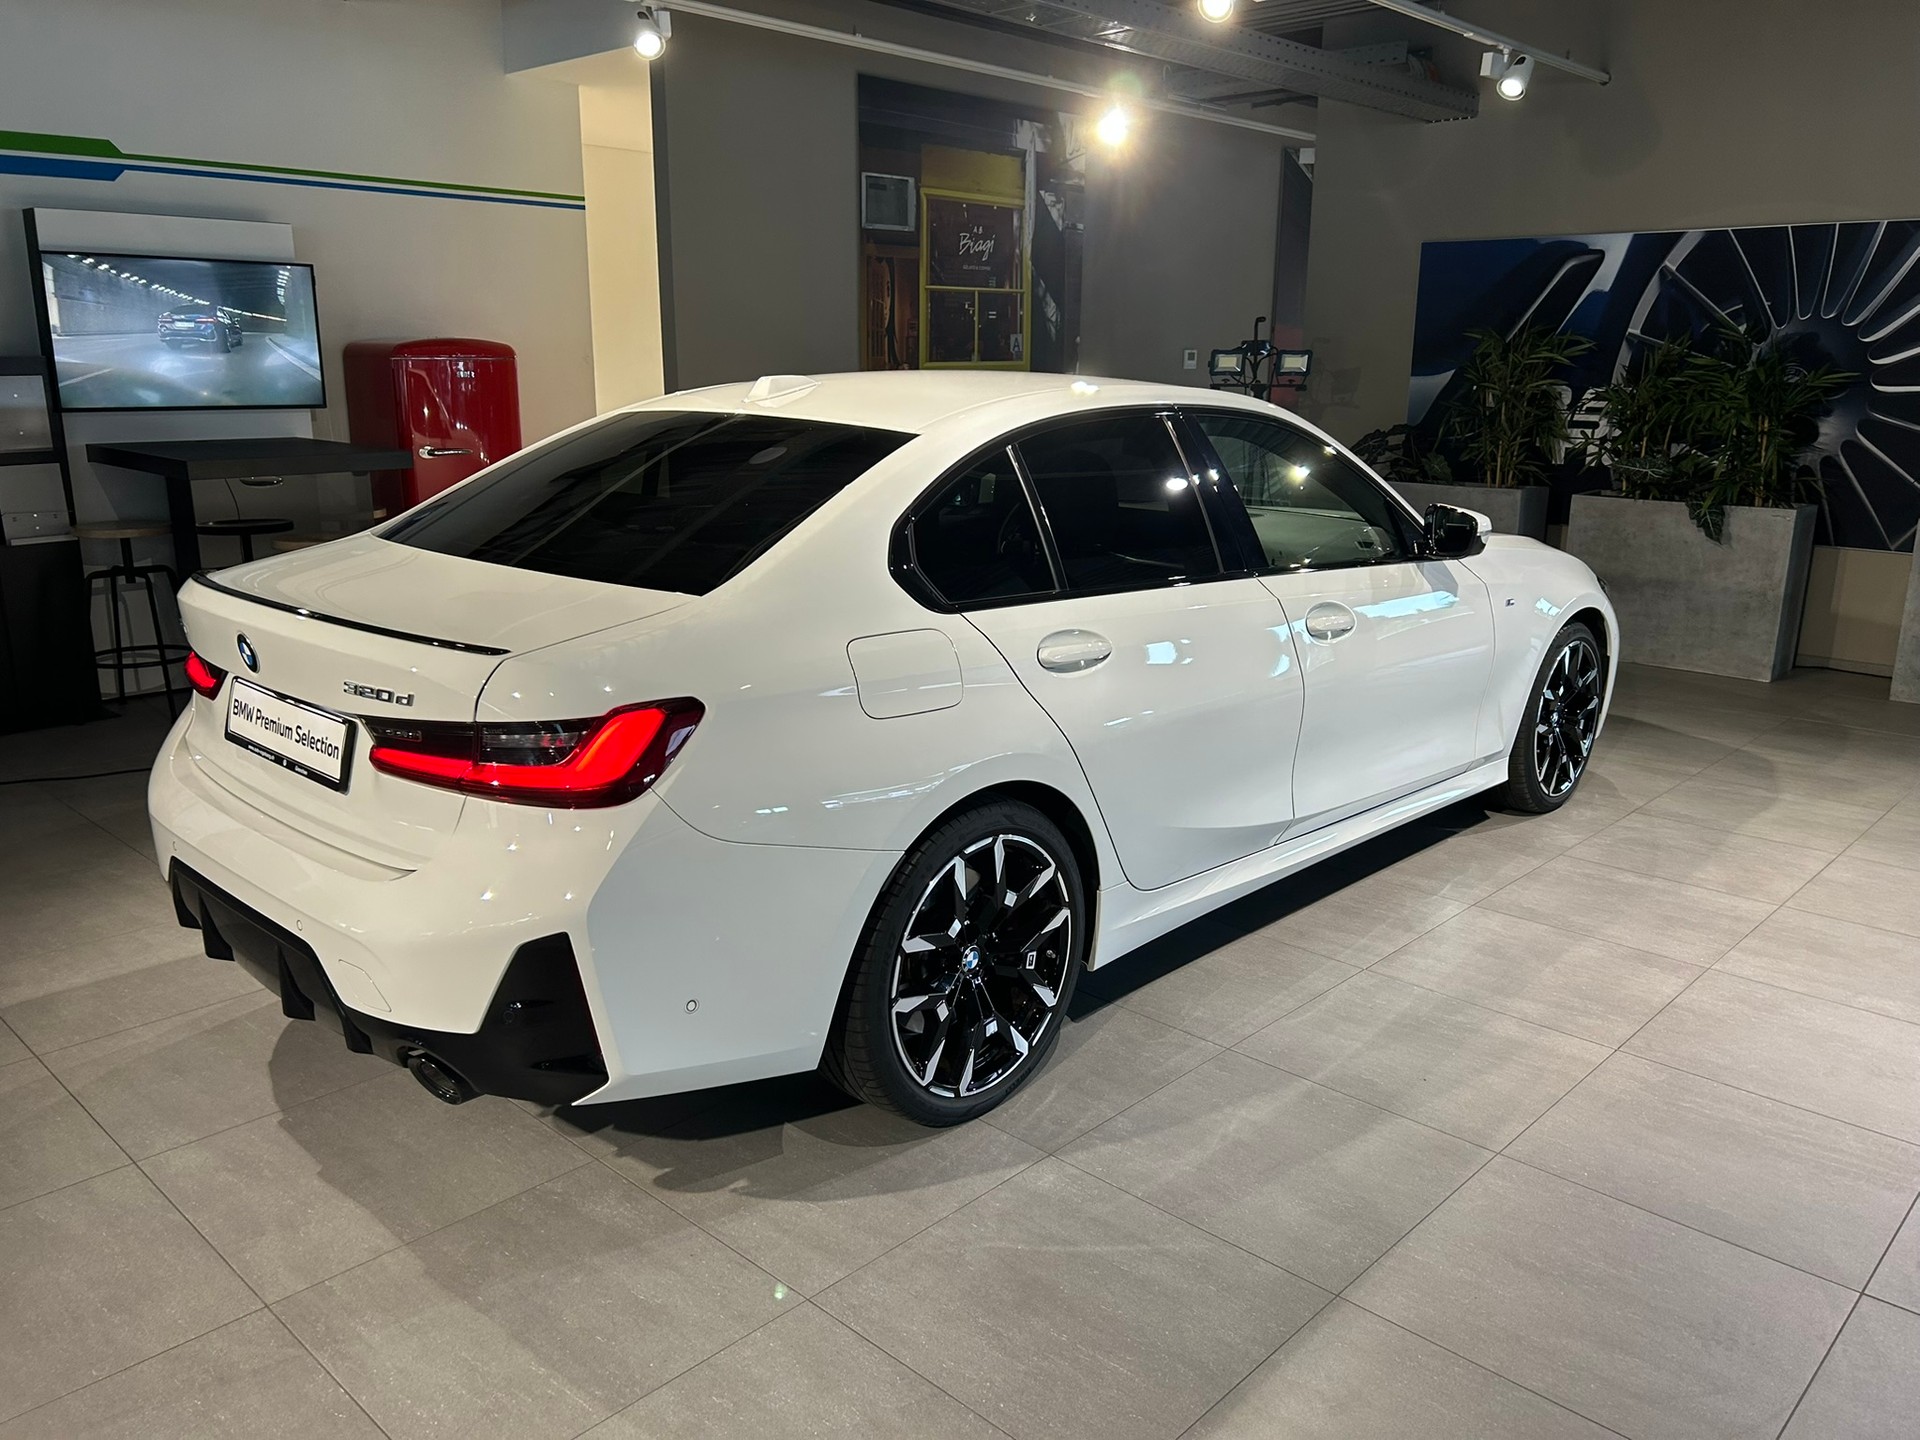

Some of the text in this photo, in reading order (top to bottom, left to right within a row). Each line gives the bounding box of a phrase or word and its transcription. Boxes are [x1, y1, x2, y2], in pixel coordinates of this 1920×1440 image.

[959, 233, 996, 261] Biagi
[344, 681, 415, 707] 320d
[233, 698, 255, 722] BMW
[256, 708, 293, 740] Premium
[295, 725, 339, 760] Selection
